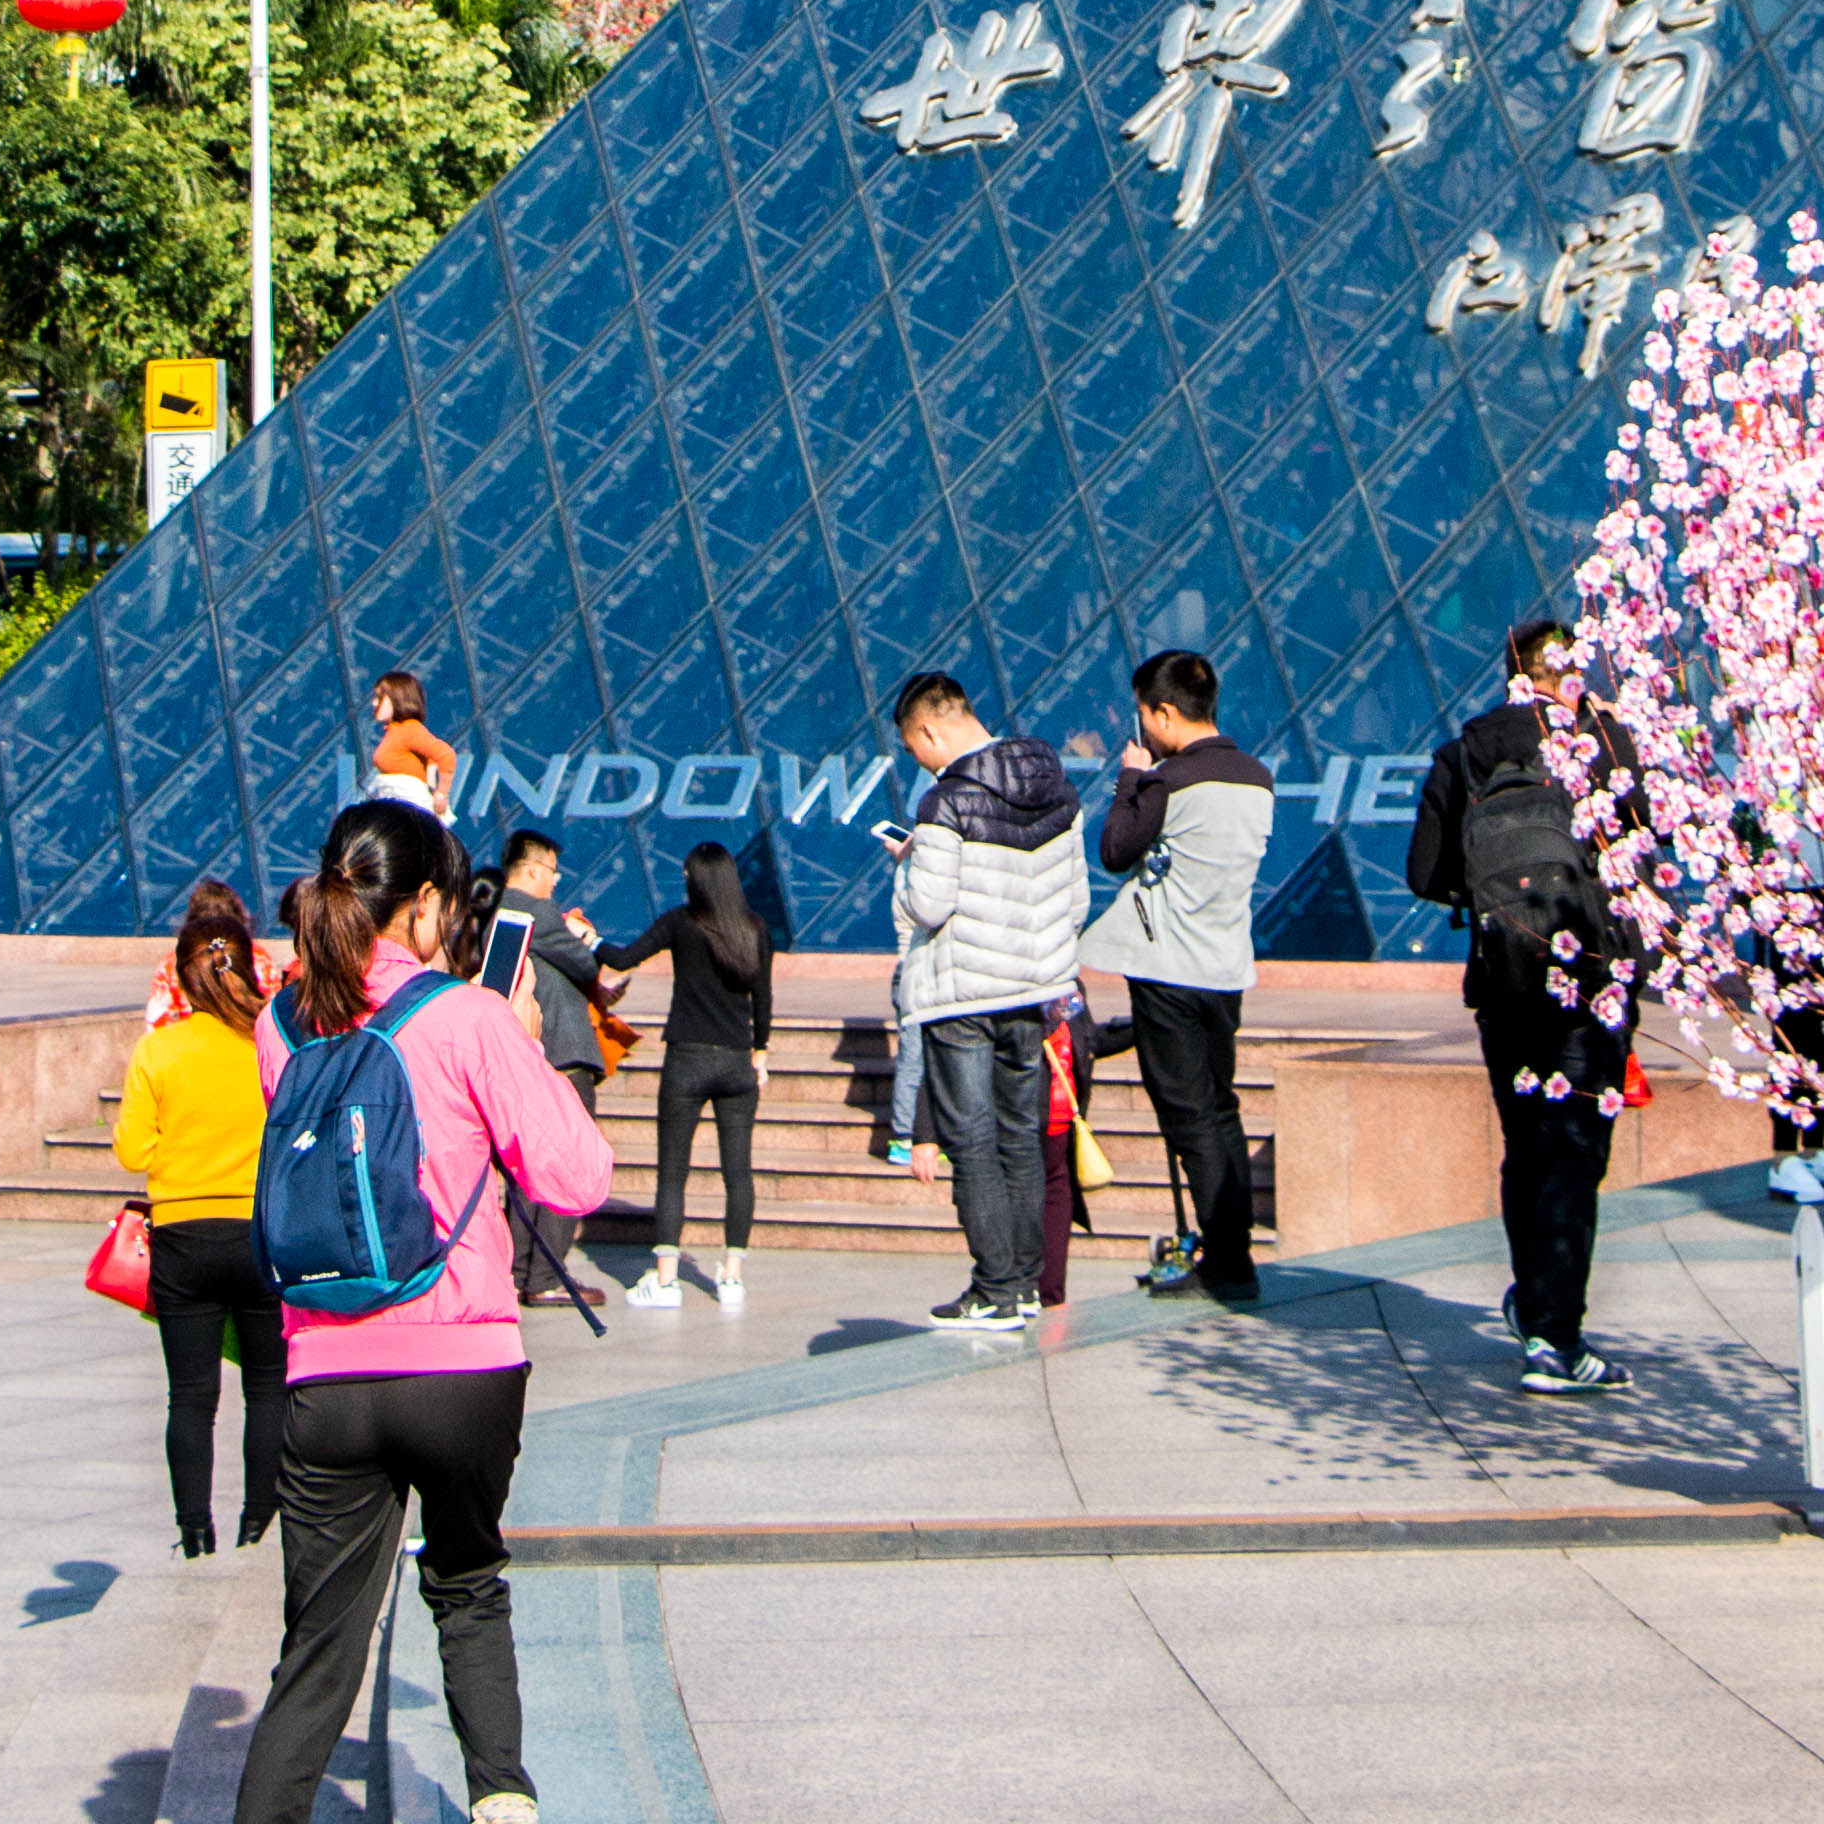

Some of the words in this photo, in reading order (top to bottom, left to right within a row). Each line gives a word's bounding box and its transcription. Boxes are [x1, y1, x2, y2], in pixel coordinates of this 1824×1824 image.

[167, 442, 196, 510] 交通
[336, 752, 896, 825] INDOW
[1258, 754, 1434, 824] HE
